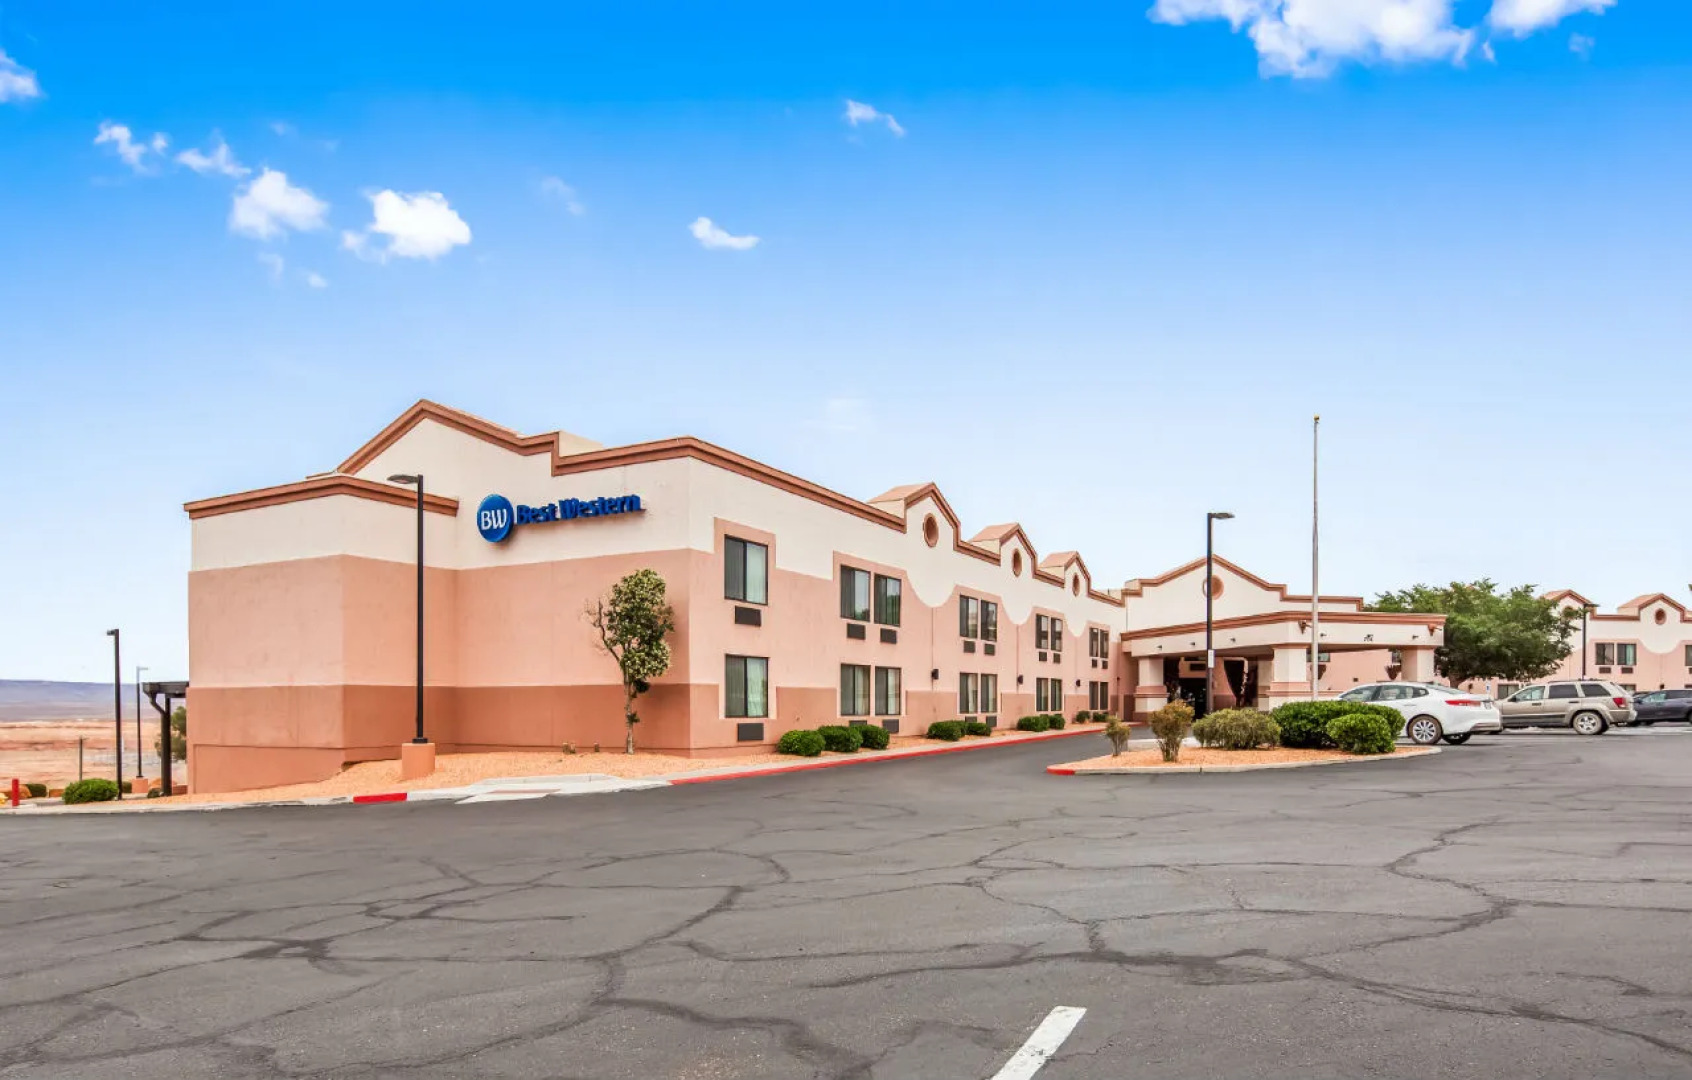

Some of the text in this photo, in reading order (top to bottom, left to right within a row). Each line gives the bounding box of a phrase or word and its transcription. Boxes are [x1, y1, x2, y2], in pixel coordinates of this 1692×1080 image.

[481, 508, 507, 530] BW
[516, 494, 641, 525] Best Western
